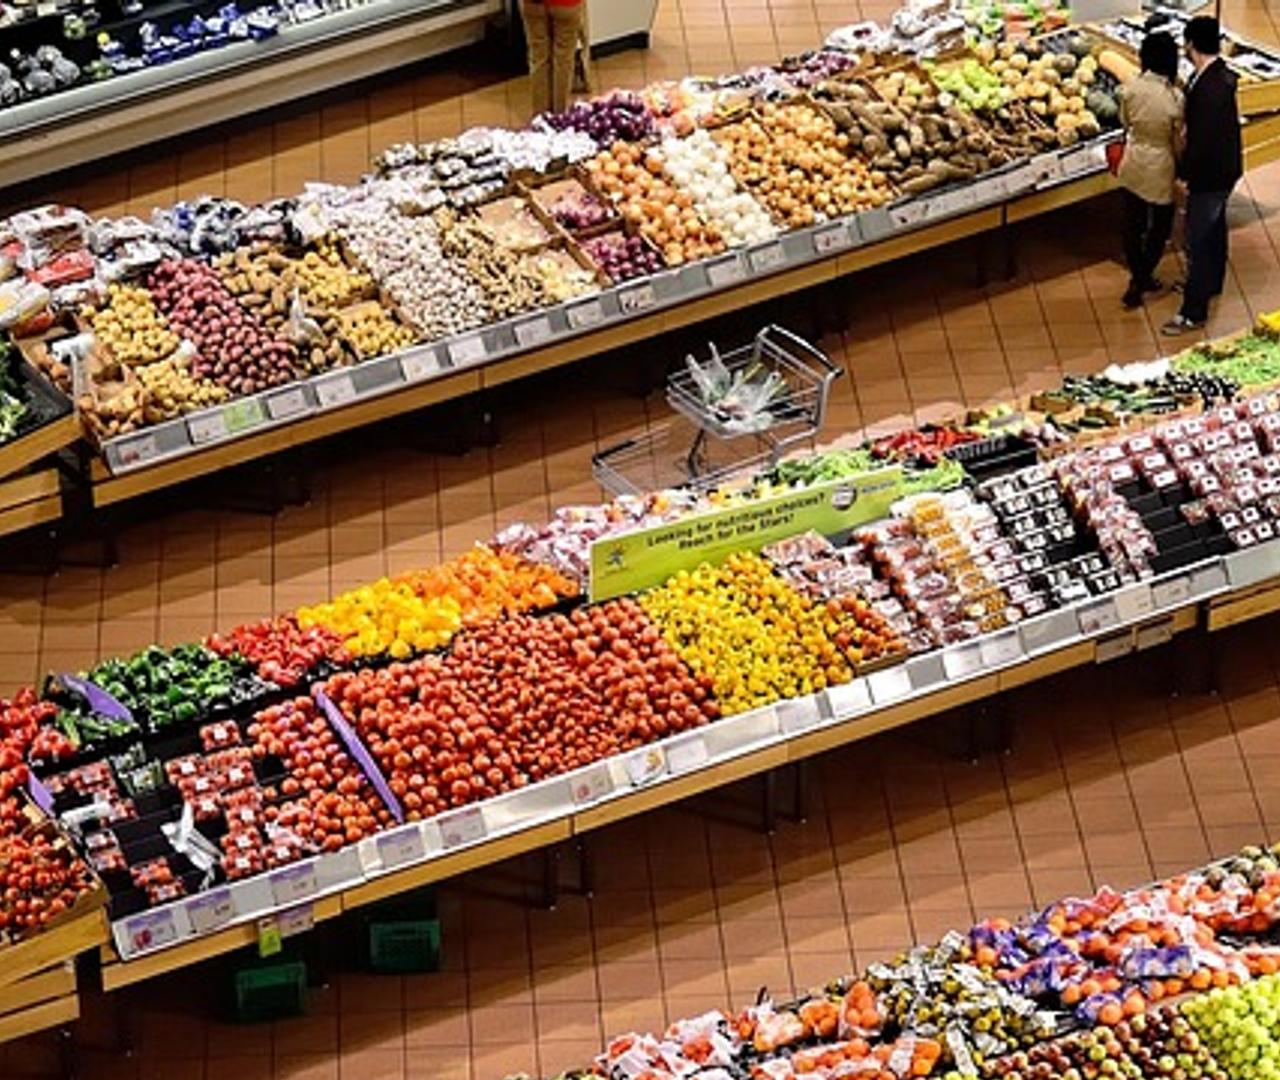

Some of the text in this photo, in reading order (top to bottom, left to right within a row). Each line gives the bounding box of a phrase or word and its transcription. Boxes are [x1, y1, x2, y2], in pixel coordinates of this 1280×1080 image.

[647, 527, 692, 547] Looking
[696, 522, 713, 532] for
[715, 508, 773, 529] nutritious
[775, 492, 825, 514] choices?
[679, 513, 794, 549] Reach for the Stars!
